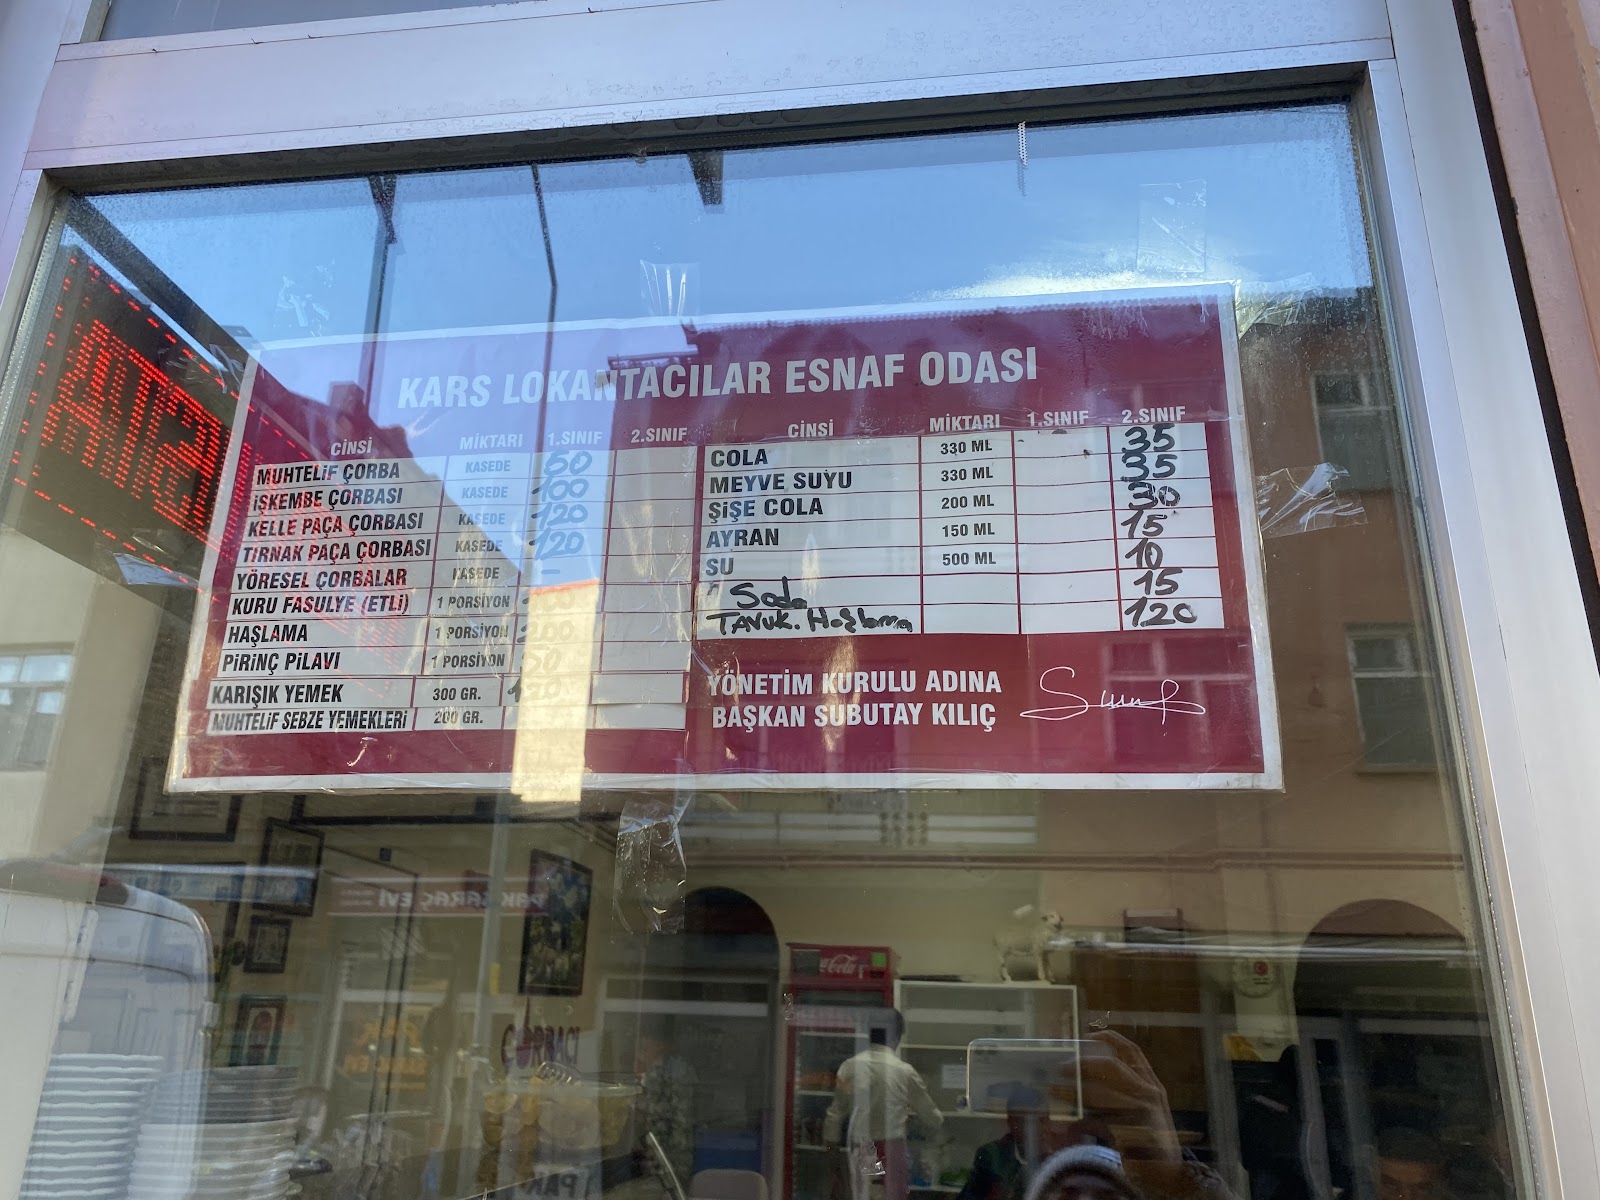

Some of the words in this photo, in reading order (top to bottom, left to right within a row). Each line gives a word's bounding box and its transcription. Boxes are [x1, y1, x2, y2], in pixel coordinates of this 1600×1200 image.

[398, 374, 491, 408] KARS
[503, 361, 770, 404] LOKANTACILAR
[786, 354, 904, 393] ESNAF
[920, 347, 1037, 386] ODASI
[930, 413, 1000, 432] MİKTARI
[1027, 410, 1088, 427] 1.SINIF
[1121, 406, 1186, 423] 2.SINIF
[631, 427, 687, 443] 2.SINIF
[788, 419, 834, 438] CİNSİ
[1121, 422, 1176, 453] 35
[331, 437, 372, 456] CİNSİ
[460, 433, 523, 451] MİKTARI
[548, 431, 602, 446] 1.SINIF
[940, 441, 966, 455] 330
[971, 440, 992, 452] ML
[465, 460, 512, 474] KASEDE
[711, 449, 768, 467] COLA
[1120, 452, 1178, 482] 35
[343, 463, 400, 484] ÇORBA
[710, 473, 785, 493] MEYVE
[793, 471, 852, 489] SUYU
[941, 468, 967, 482] 330
[972, 467, 993, 479] ML
[462, 486, 508, 499] KASEDE
[532, 475, 589, 502] 100
[1128, 482, 1181, 509] 30
[329, 488, 403, 510] ÇORBASI
[764, 498, 823, 516] COLA
[941, 496, 967, 510] 200
[973, 495, 994, 507] ML
[458, 513, 505, 526] KASEDE
[531, 502, 588, 530] 120
[1121, 509, 1168, 539] 15
[248, 519, 297, 538] KELLE
[302, 516, 343, 539] PAÇA
[349, 513, 424, 537] ÇORBASI
[942, 524, 969, 538] 150
[973, 523, 995, 535] ML
[455, 540, 503, 553] KASEDE
[527, 527, 584, 560] 120
[706, 528, 779, 549] AYRAN
[243, 546, 304, 563] TIRNAK
[308, 543, 351, 566] PAÇA
[356, 539, 431, 564] ÇORBASI
[942, 552, 969, 566] 500
[974, 552, 996, 565] ML
[1125, 538, 1163, 570] 10
[453, 567, 499, 580] KASEDE
[705, 558, 734, 576] SU
[237, 568, 310, 591] YÖRESEL
[316, 569, 407, 591] ÇORBALAR
[1134, 568, 1183, 595] 15
[437, 597, 443, 609] 1
[448, 593, 510, 609] PORSİYON
[730, 576, 808, 610] Soda
[232, 597, 278, 615] KURU
[282, 595, 355, 613] FASULYE
[1124, 596, 1198, 627] 120
[228, 624, 308, 647] HAŞLAMA
[435, 626, 440, 639] 1
[447, 624, 508, 639] PORSİYON
[432, 656, 437, 668] 1
[443, 653, 505, 668] PORSİYON
[707, 669, 813, 697] YÖNETİM
[822, 671, 917, 695] KURULU
[925, 670, 1002, 693] ADINA
[212, 685, 280, 709] KARIŞIK
[284, 684, 344, 703] YEMEK
[433, 688, 457, 701] 300
[460, 687, 481, 701] GR.
[282, 711, 325, 729] SEBZE
[434, 711, 458, 724] 200
[462, 711, 483, 724] GR.
[712, 705, 804, 733] BAŞKAN
[814, 704, 924, 729] SUBUTAY
[932, 703, 996, 733] KILIÇ
